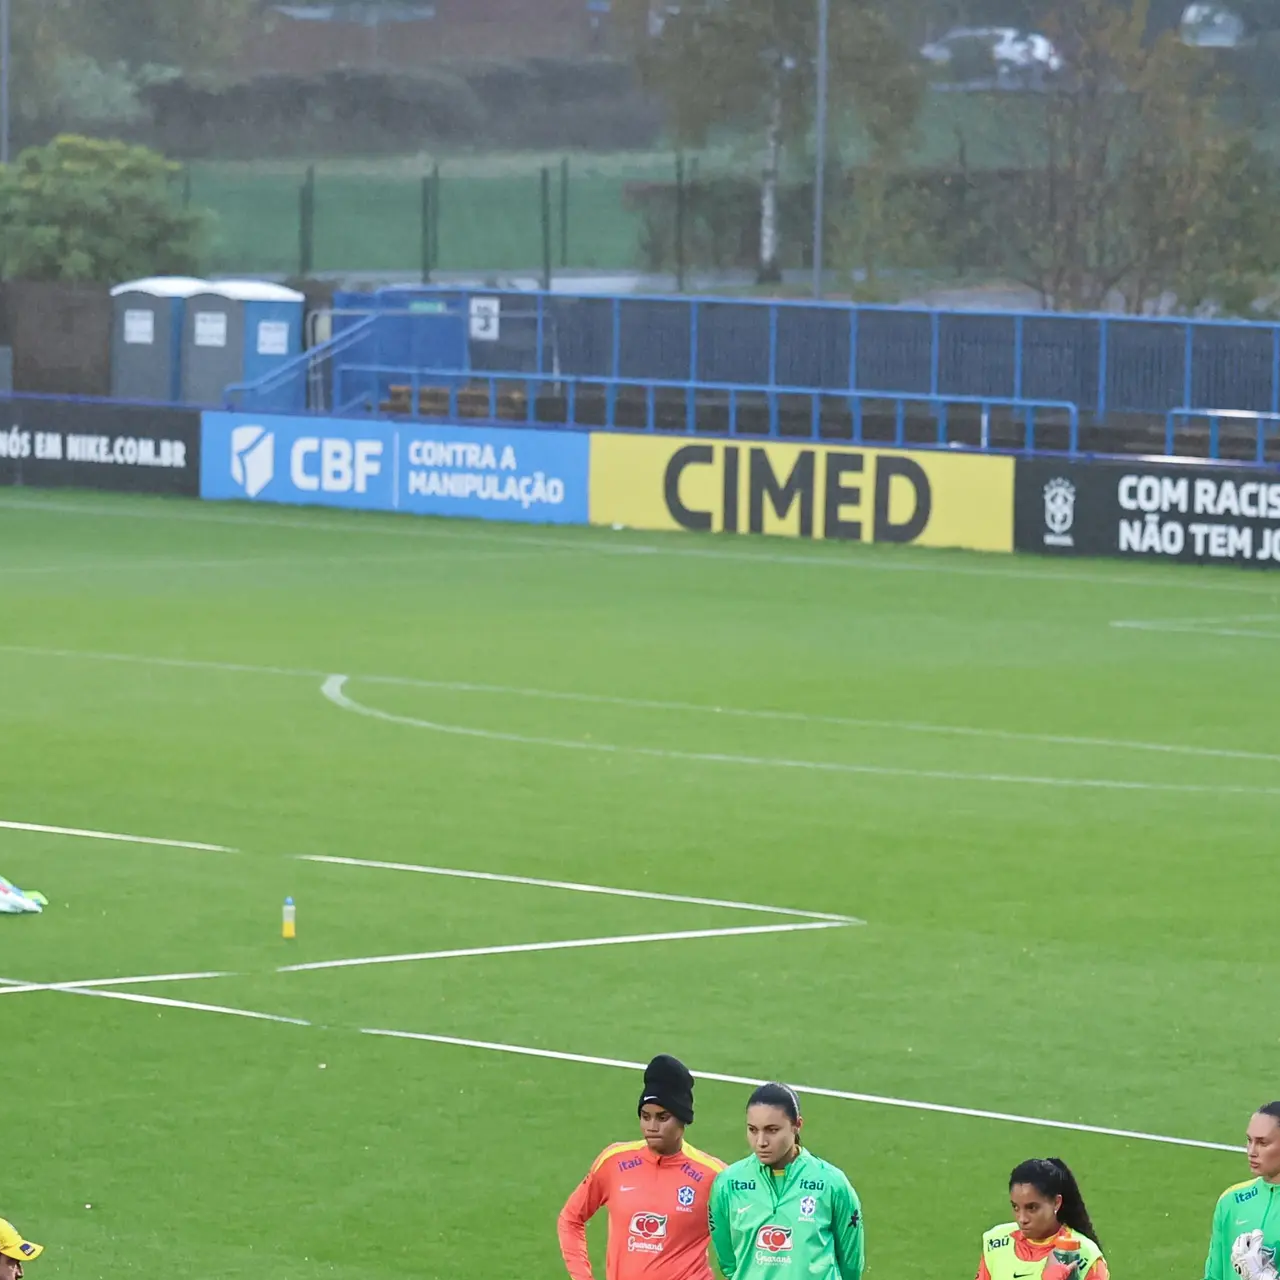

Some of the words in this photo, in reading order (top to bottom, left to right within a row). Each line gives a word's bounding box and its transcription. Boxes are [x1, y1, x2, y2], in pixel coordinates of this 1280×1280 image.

[35, 432, 62, 460] EM
[67, 433, 187, 468] NIKE.COM.BR
[290, 437, 383, 493] CBF
[409, 440, 497, 470] CONTRA
[500, 445, 517, 471] A
[409, 470, 565, 509] MANIPULAÇÃO
[663, 443, 932, 545] CIMED
[1118, 475, 1188, 513] COM
[1118, 513, 1185, 555] NÃO
[1189, 522, 1252, 559] TEM
[731, 1179, 756, 1192] itaú
[799, 1178, 825, 1192] itaú
[1234, 1186, 1258, 1204] itaú
